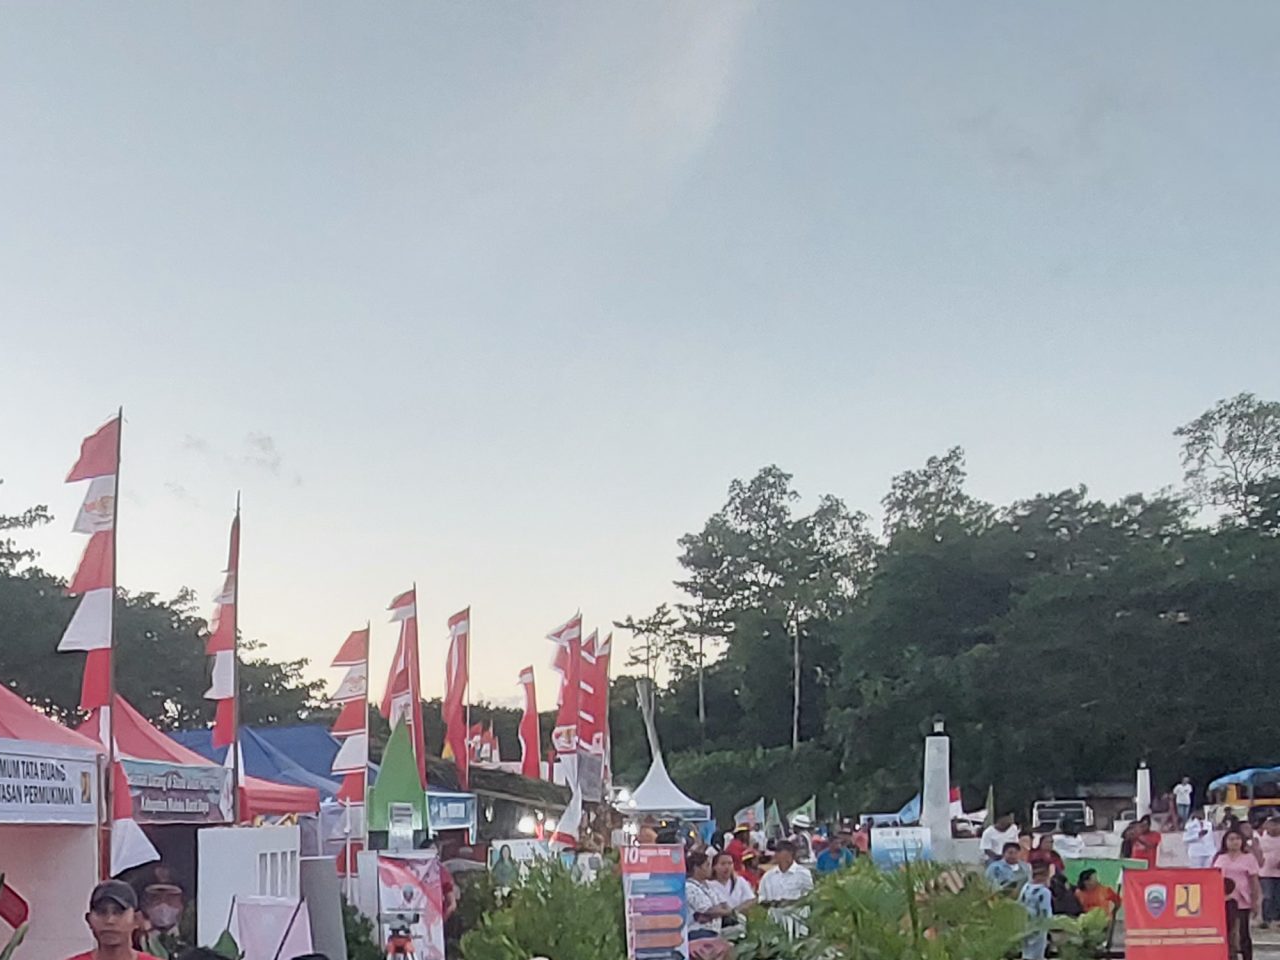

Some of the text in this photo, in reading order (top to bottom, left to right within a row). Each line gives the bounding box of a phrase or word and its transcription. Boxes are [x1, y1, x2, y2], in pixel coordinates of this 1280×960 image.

[21, 760, 40, 780] TATA
[40, 763, 67, 782] RUANG
[23, 785, 74, 805] PERMUKIMAN
